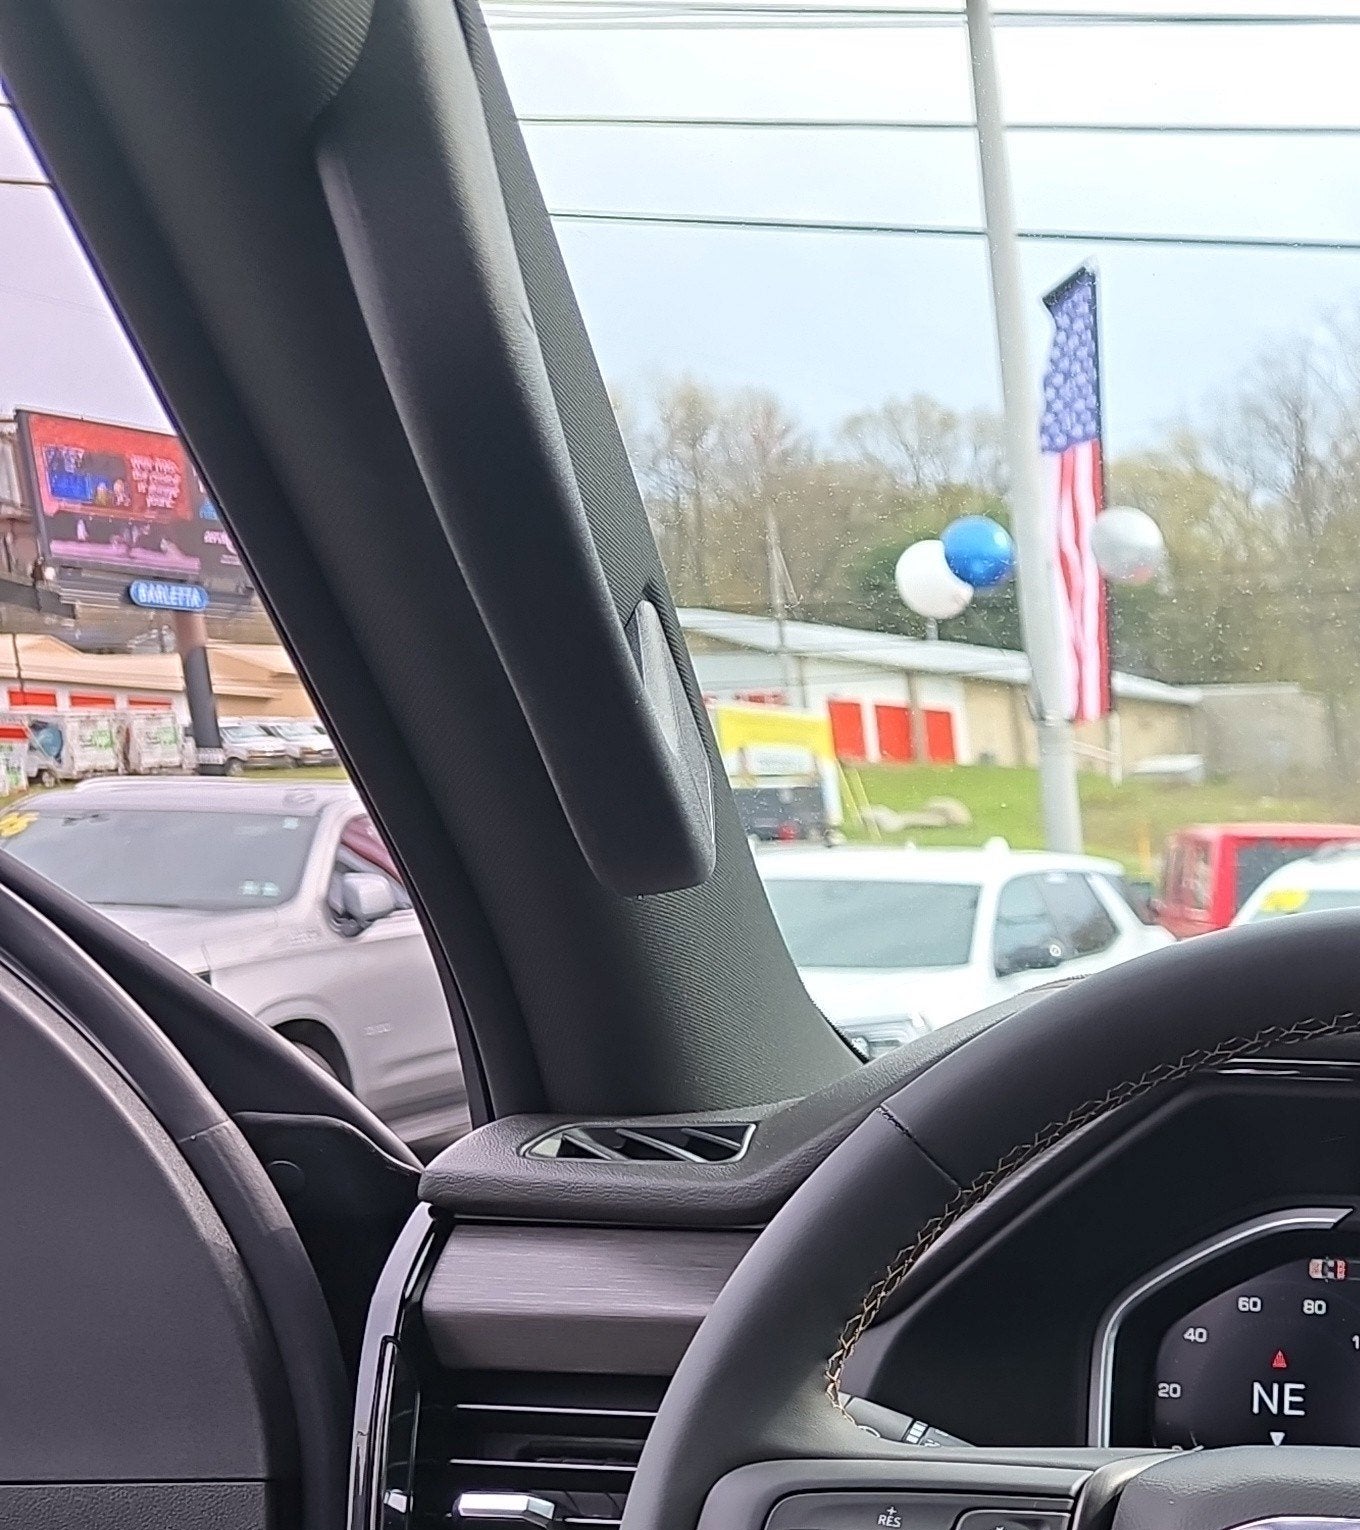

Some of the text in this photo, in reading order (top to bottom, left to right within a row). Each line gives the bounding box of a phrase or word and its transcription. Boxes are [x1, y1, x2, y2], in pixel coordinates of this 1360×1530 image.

[138, 582, 202, 608] BARLETTA
[1238, 1296, 1262, 1312] 60
[1303, 1299, 1327, 1315] 80
[1183, 1327, 1208, 1343] 40
[1157, 1382, 1182, 1398] 20
[1252, 1381, 1306, 1416] NE
[877, 1514, 902, 1528] RES
